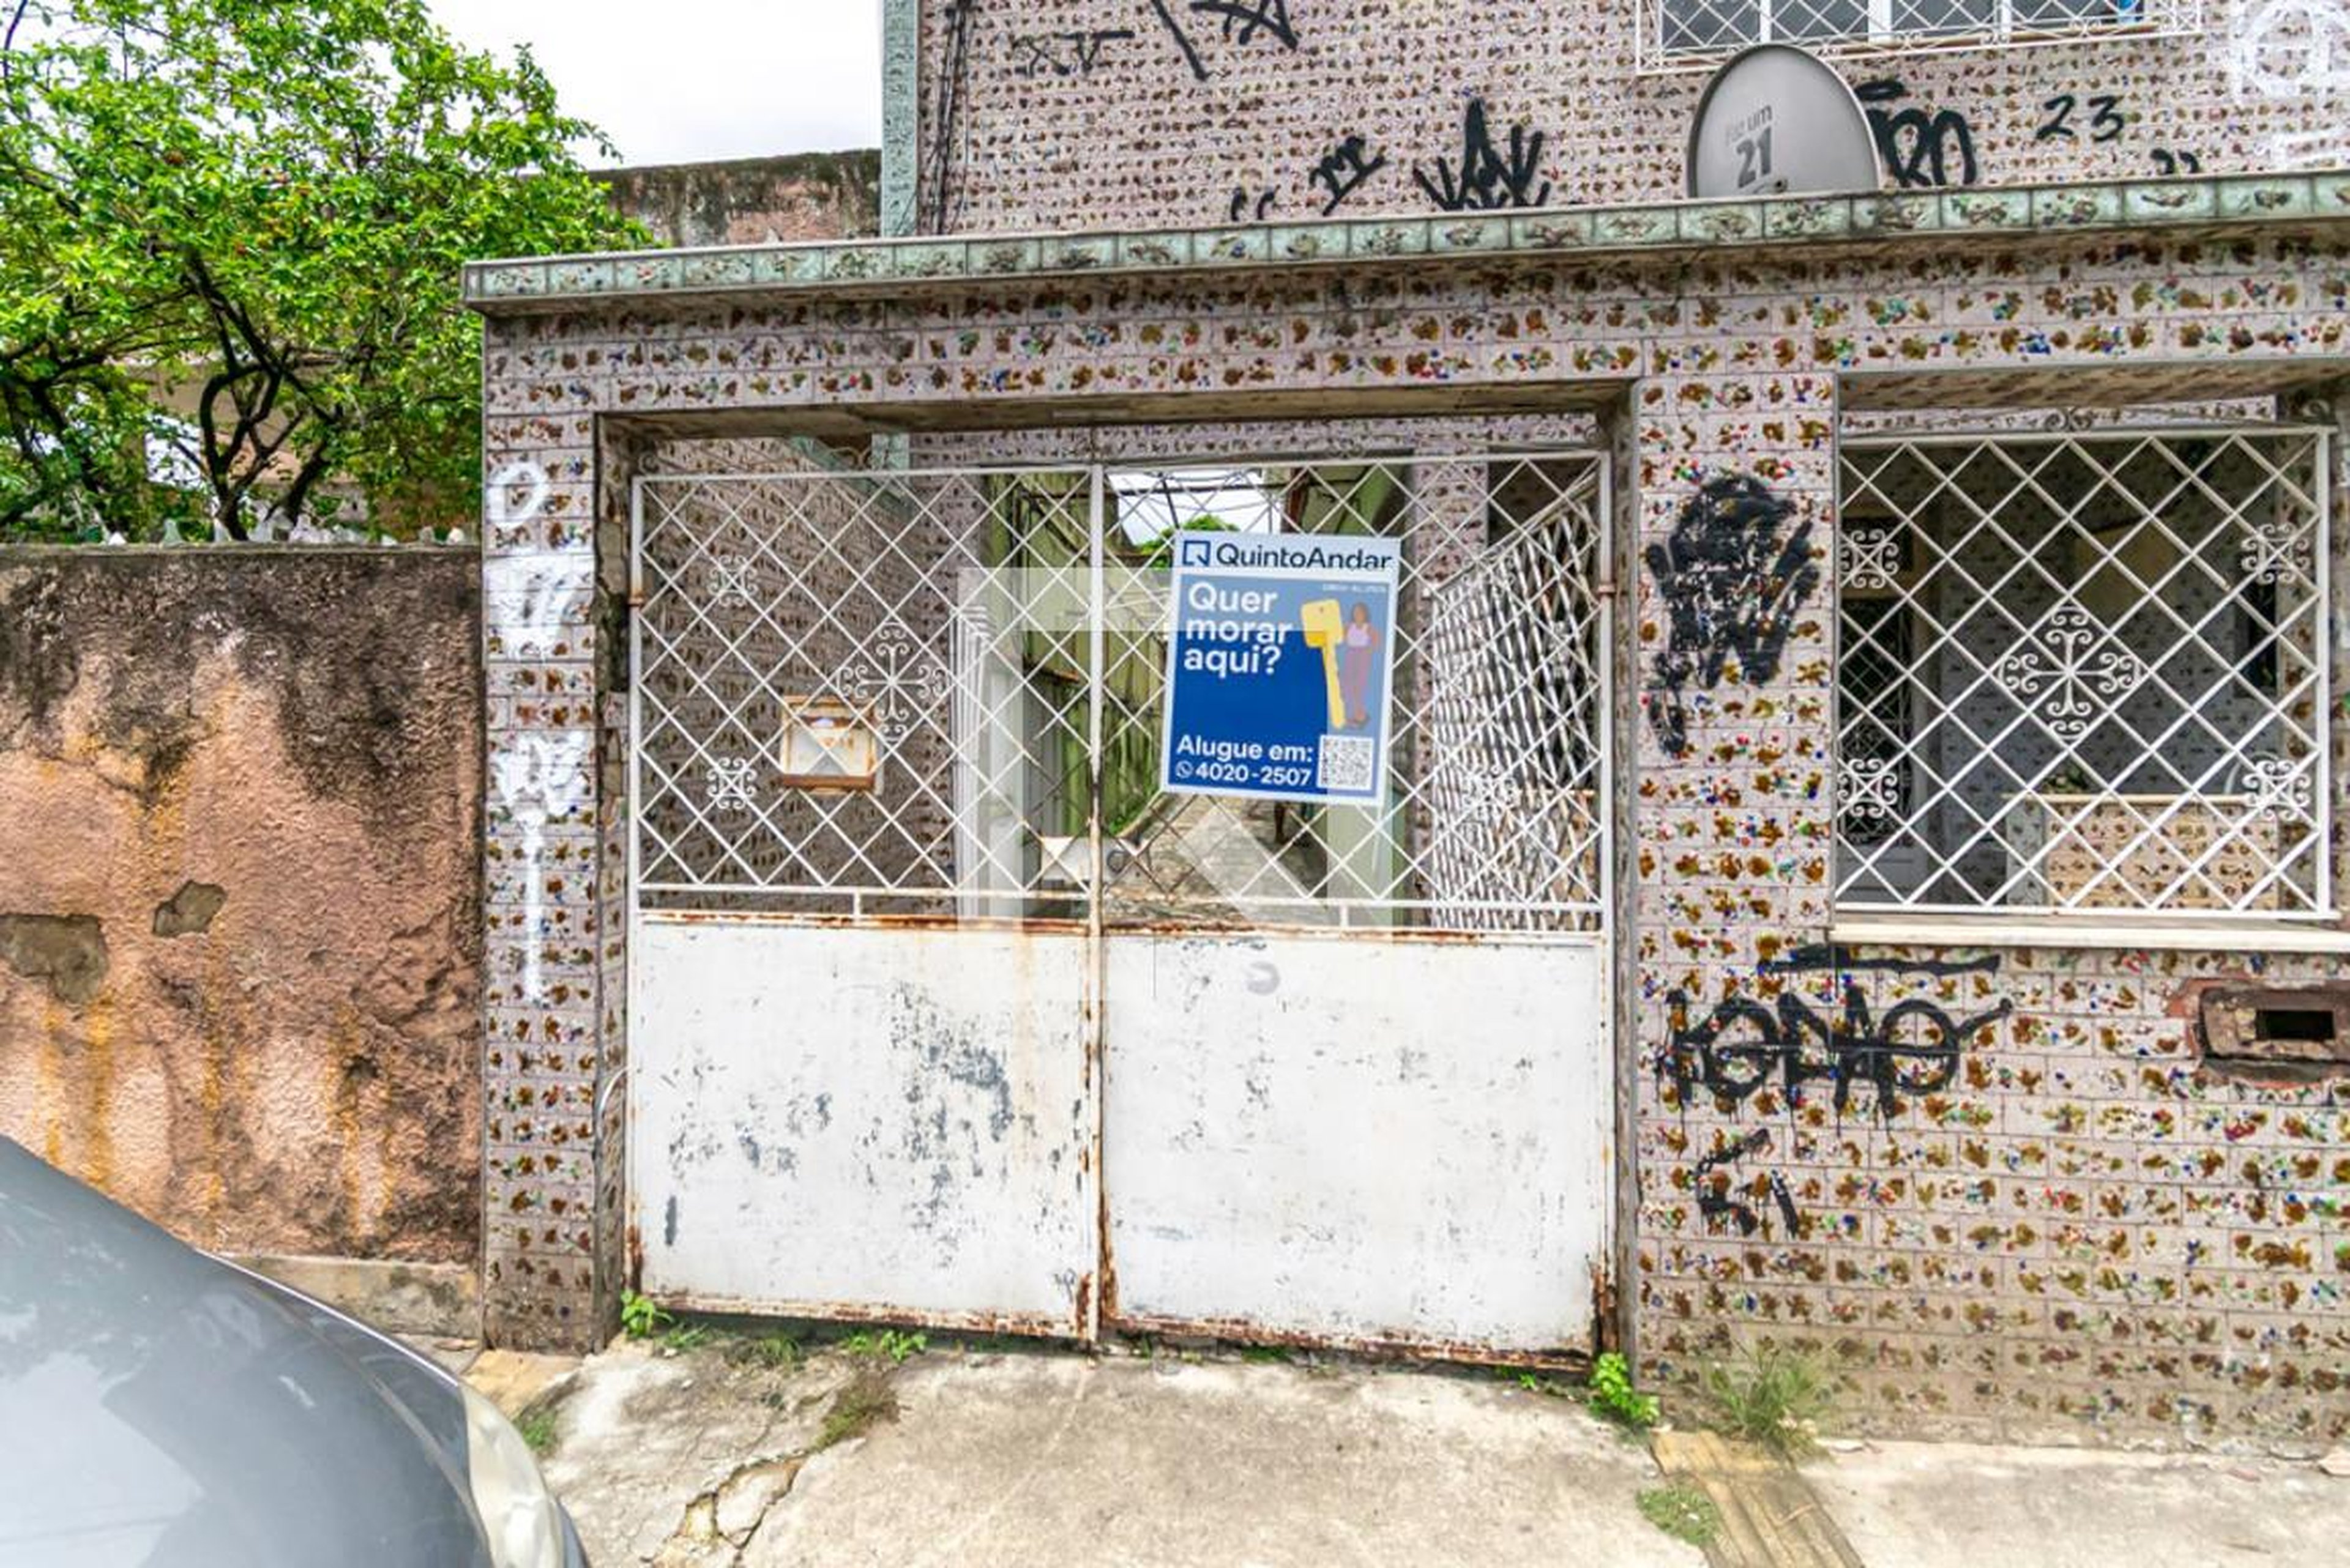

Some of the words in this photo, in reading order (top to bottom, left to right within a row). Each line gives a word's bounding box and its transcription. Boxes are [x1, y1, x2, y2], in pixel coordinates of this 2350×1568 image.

[1736, 125, 1772, 189] 21
[1216, 542, 1392, 570] QuintoAndar
[1188, 581, 1278, 614] Quer
[1185, 619, 1294, 645] morar
[1184, 644, 1281, 679] aqui?
[1176, 734, 1263, 762] Alugue
[1268, 744, 1315, 763] em:
[1195, 761, 1312, 786] 4020-2507
